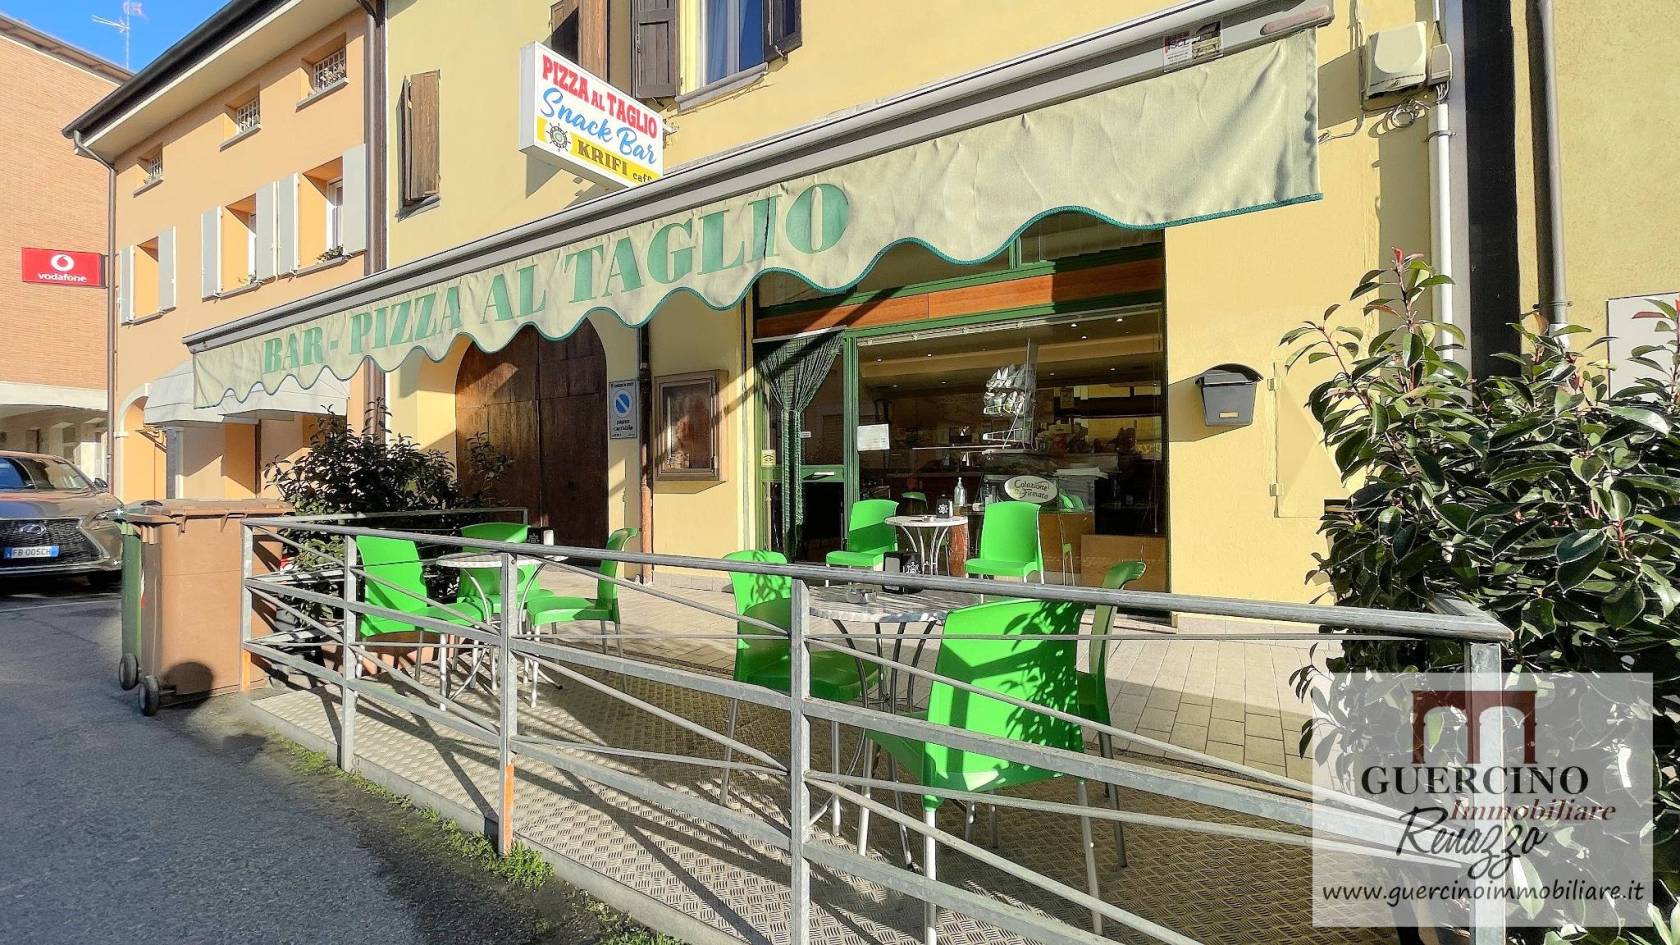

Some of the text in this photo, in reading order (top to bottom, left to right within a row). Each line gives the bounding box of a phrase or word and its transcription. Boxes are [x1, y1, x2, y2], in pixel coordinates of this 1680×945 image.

[541, 87, 657, 164] Snack Bar
[542, 54, 657, 139] PIZZA AL TAGLIO
[577, 139, 628, 176] KRIFI
[38, 273, 87, 282] vodafone
[263, 326, 323, 374] BAR
[349, 286, 463, 355] PIZZA
[480, 263, 546, 324] AL
[564, 183, 849, 303] TAGLIO
